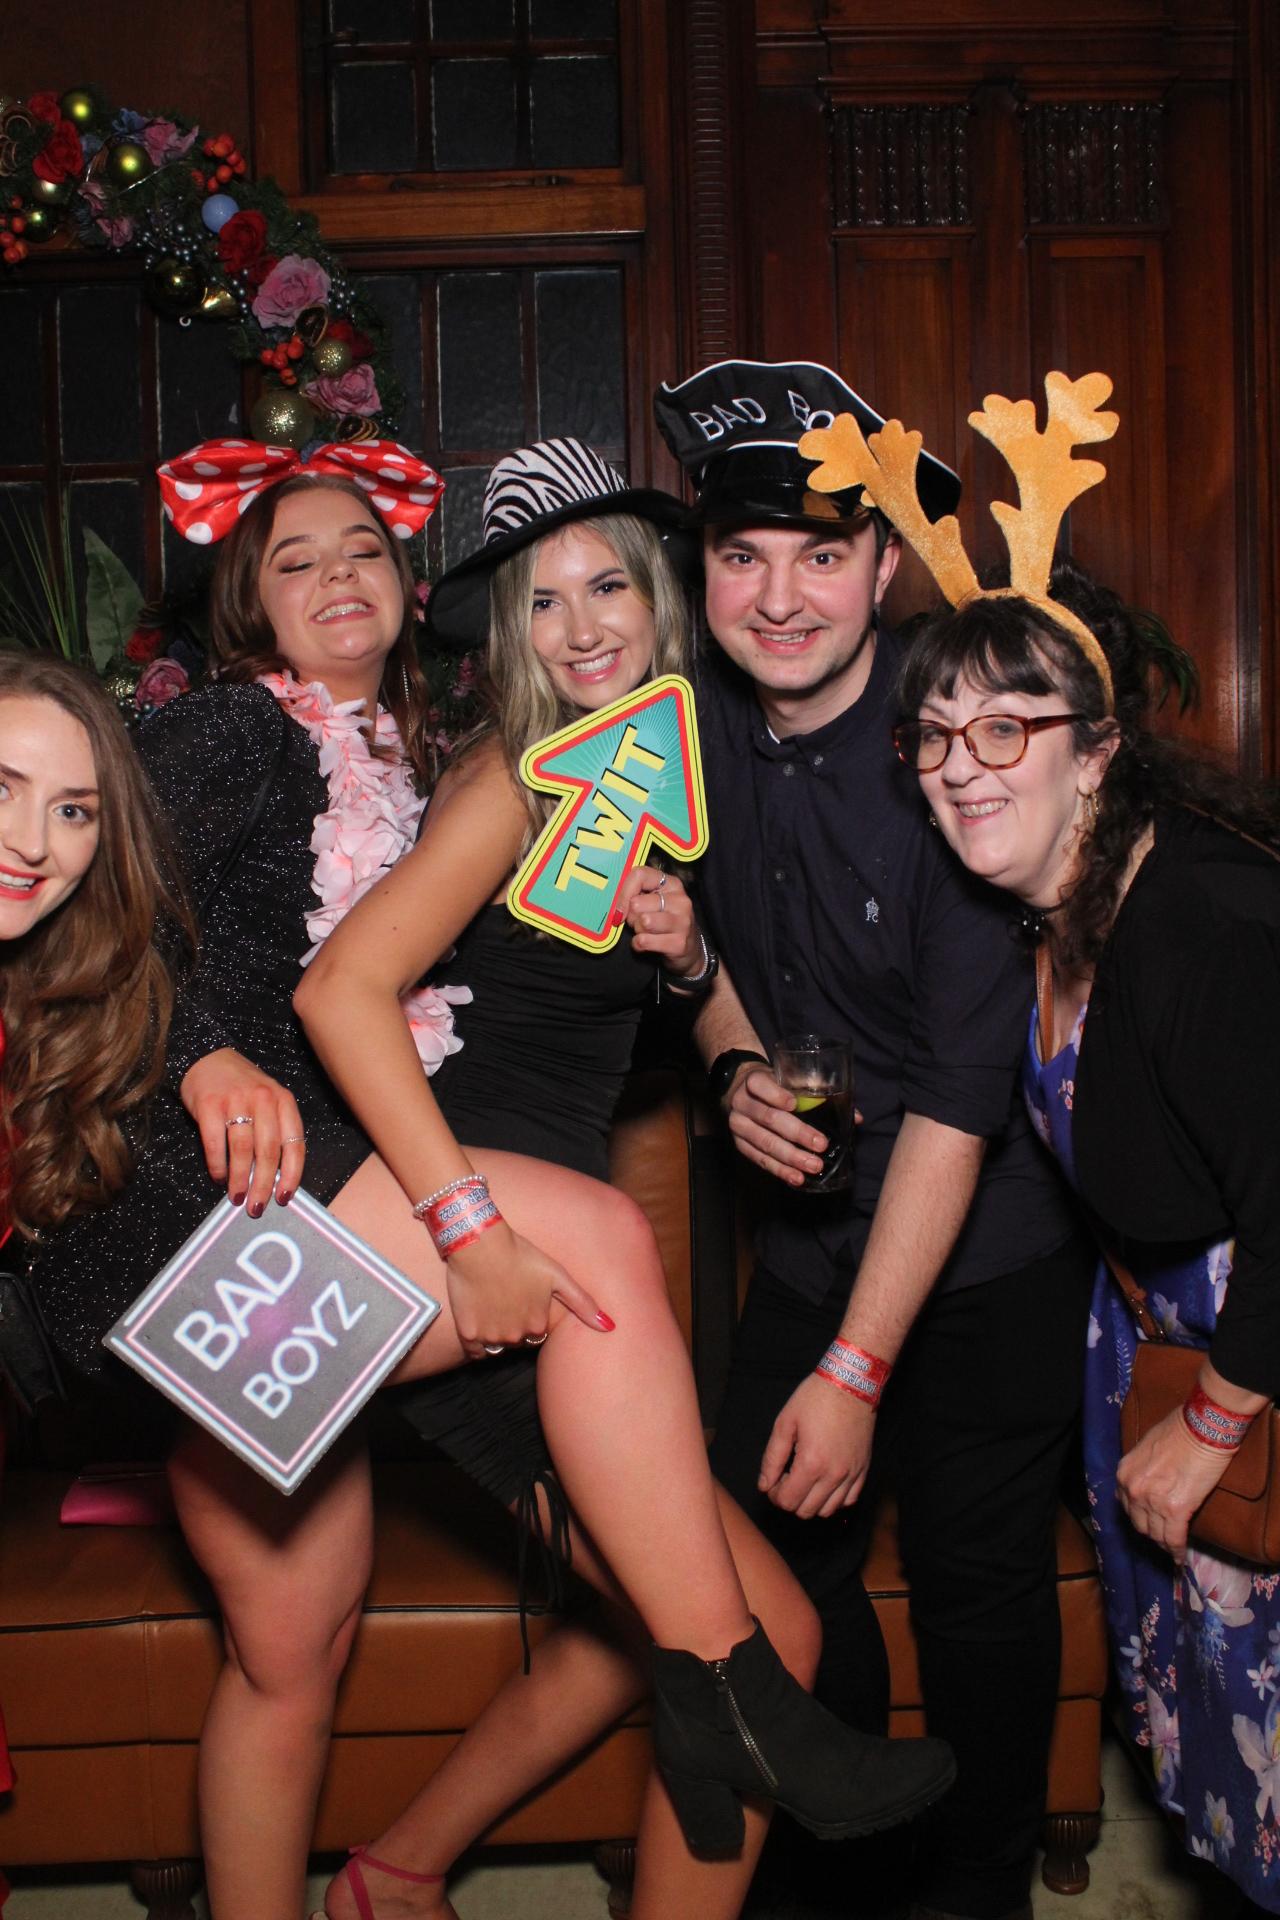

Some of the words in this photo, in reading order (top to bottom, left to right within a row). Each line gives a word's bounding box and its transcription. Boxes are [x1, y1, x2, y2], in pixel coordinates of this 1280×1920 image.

[690, 398, 766, 441] BAD
[788, 390, 835, 431] BO
[555, 723, 665, 891] TWIT
[865, 911, 879, 923] FC
[439, 1199, 467, 1222] 2022
[471, 1202, 497, 1225] MAS
[438, 1217, 471, 1246] PART
[173, 1231, 302, 1372] BAD
[242, 1280, 368, 1419] BOYZ
[844, 1351, 870, 1372] 9TH
[1204, 1408, 1231, 1428] 2022
